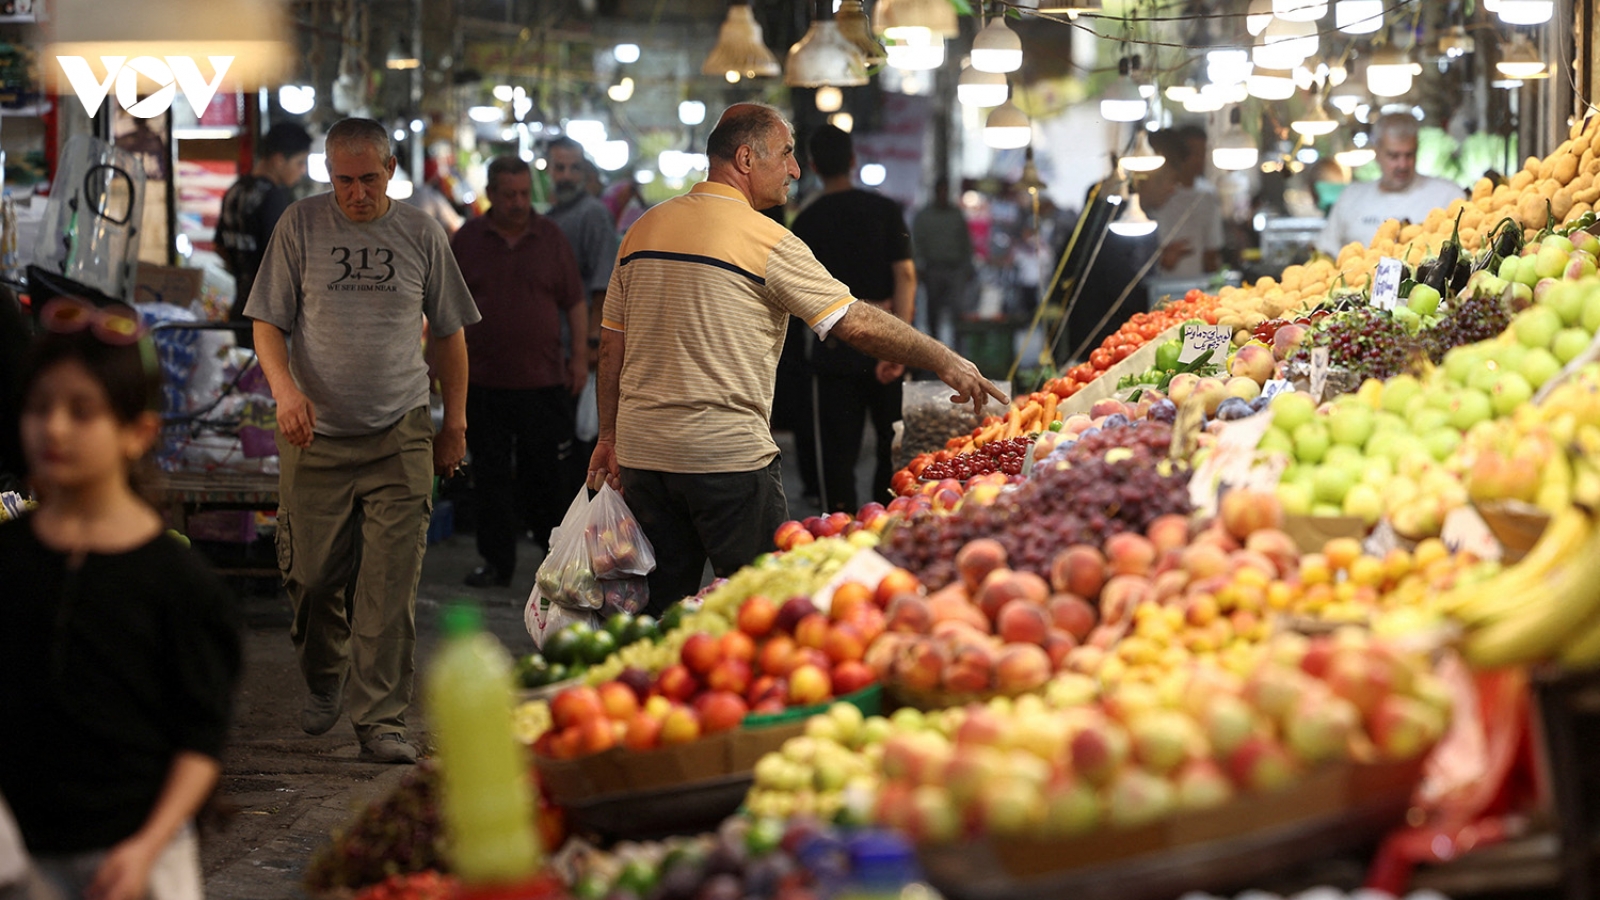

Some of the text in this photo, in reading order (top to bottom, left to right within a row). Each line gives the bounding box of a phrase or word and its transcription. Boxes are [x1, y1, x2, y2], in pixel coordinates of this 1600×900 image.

[331, 246, 396, 285] 313
[327, 284, 397, 292] WE SEE HIM NEAR
